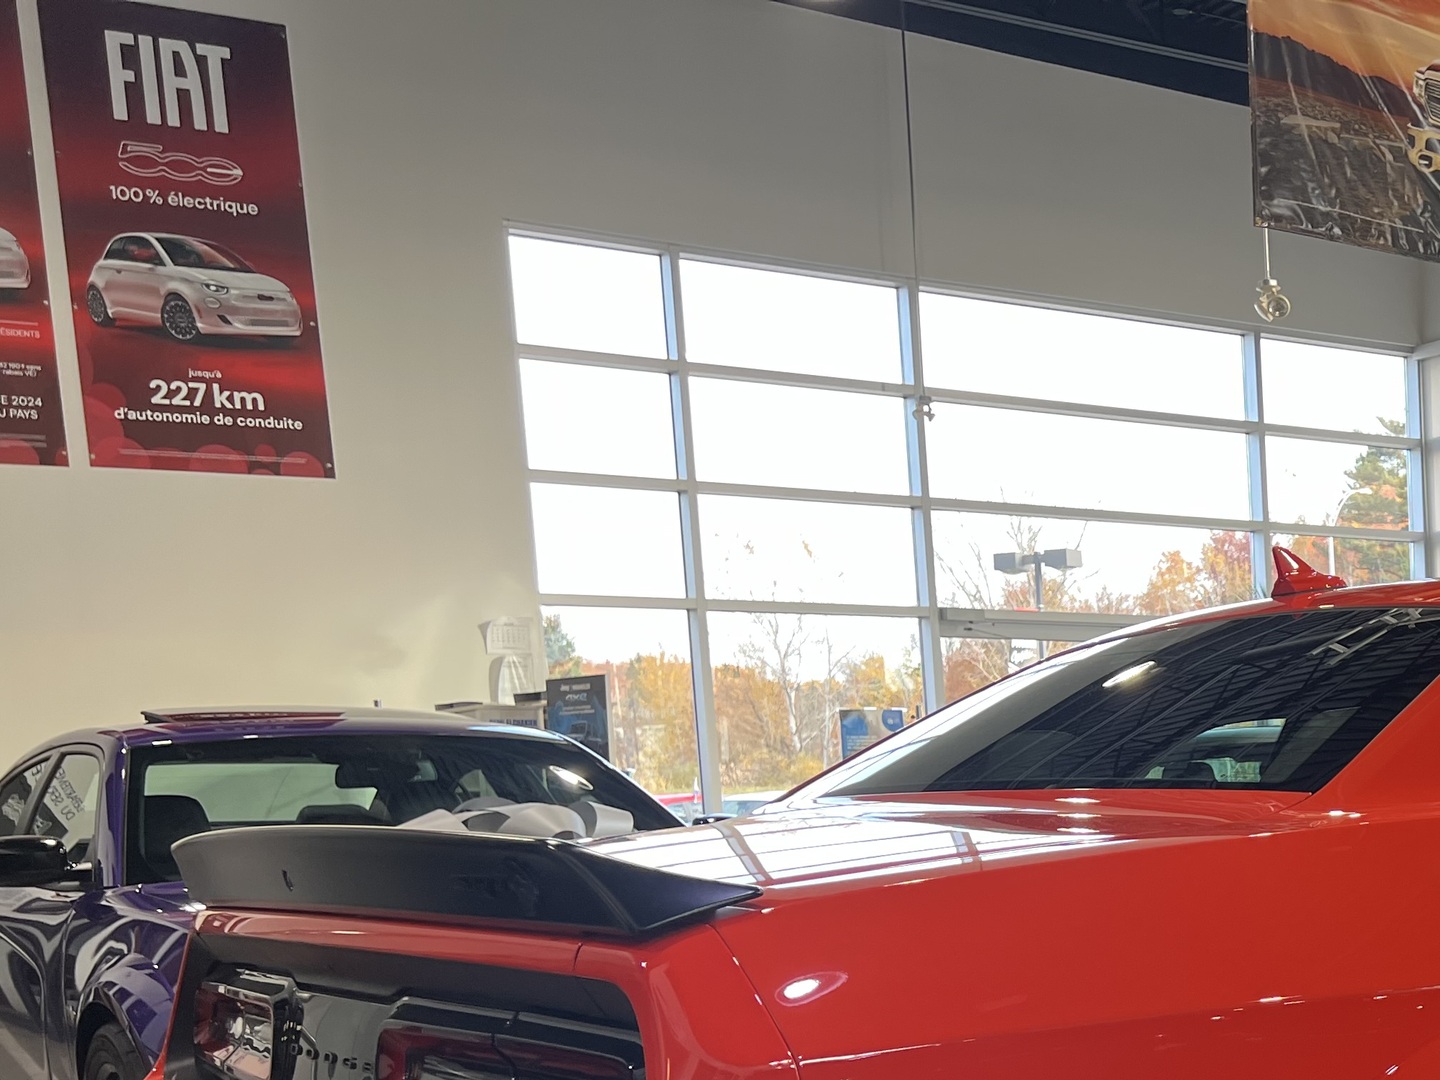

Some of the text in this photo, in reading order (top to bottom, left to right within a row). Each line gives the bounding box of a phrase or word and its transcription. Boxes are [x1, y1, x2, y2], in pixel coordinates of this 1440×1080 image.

[104, 29, 231, 134] FIAT
[109, 185, 259, 216] 100 % électrique
[188, 368, 222, 380] jusqu'à
[12, 395, 42, 407] 2024
[149, 378, 265, 411] 227 km
[9, 408, 39, 420] PAYS
[114, 406, 304, 431] d'autonomie de conduite
